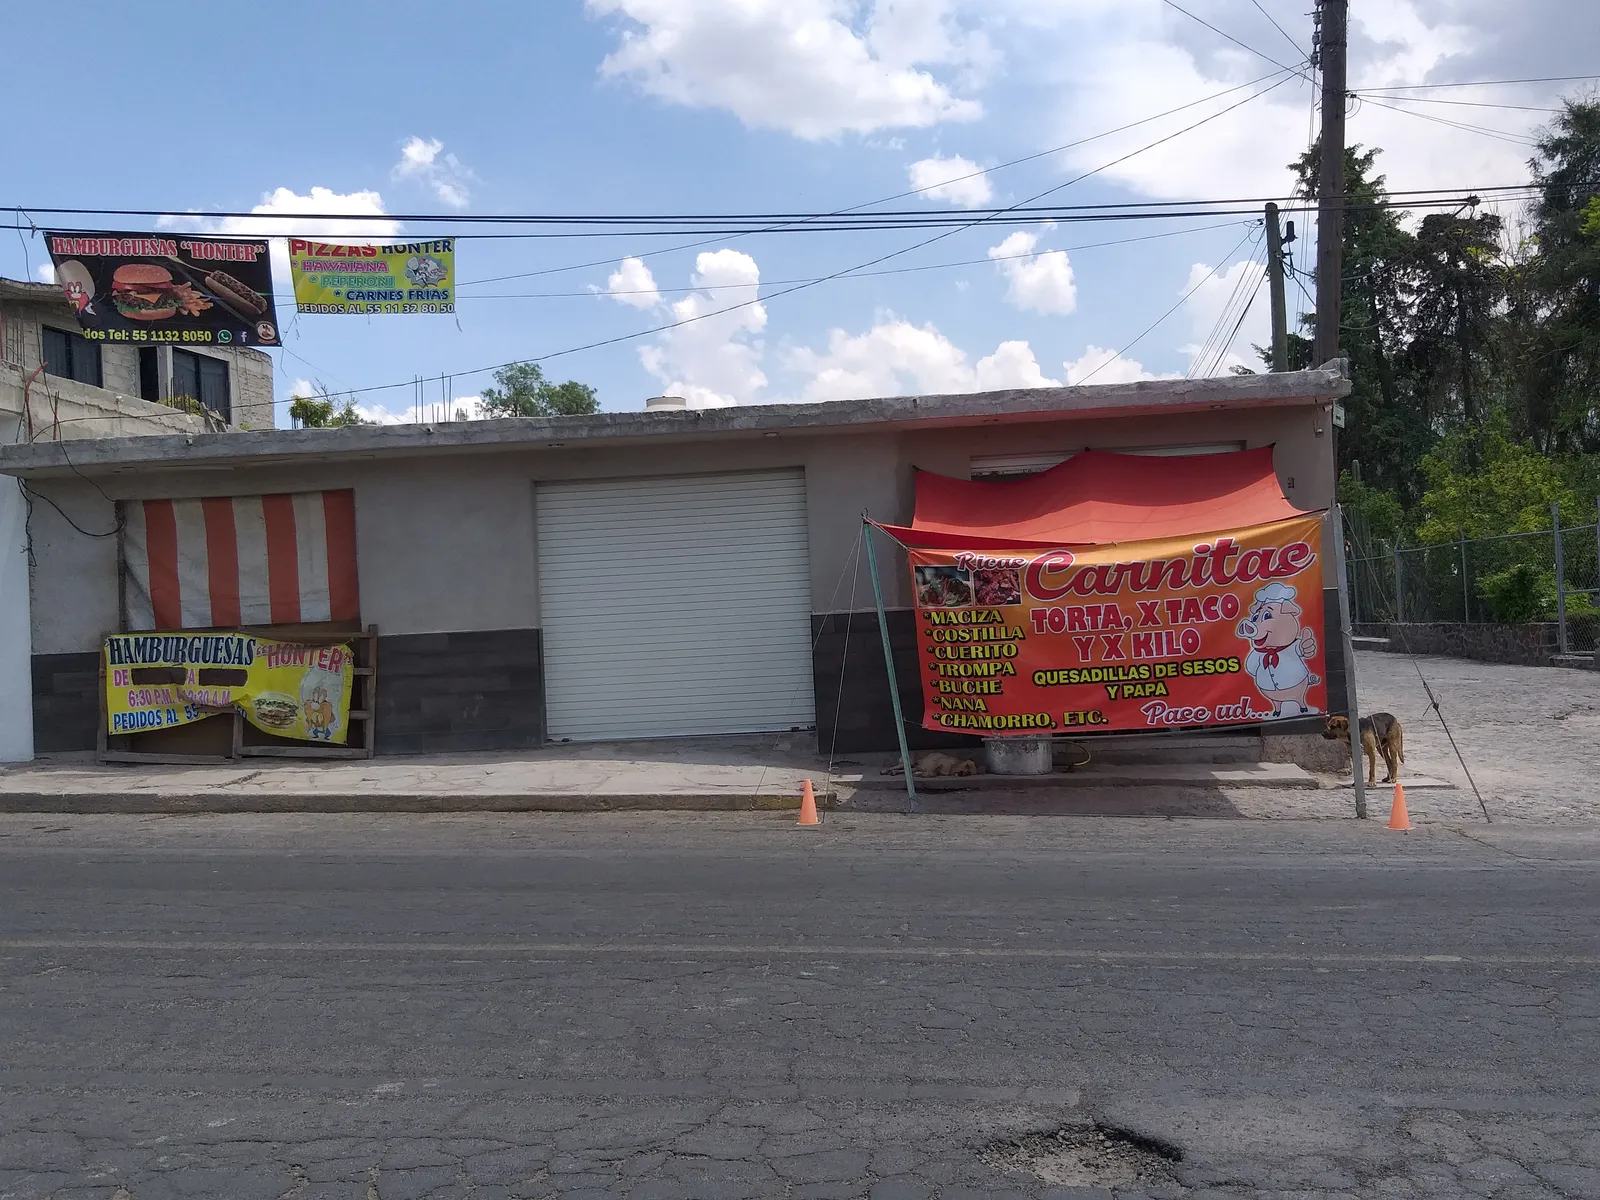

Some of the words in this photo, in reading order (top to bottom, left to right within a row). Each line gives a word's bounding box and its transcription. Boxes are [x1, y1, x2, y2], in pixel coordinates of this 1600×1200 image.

[52, 237, 177, 257] HAMBURGUESAS
[291, 239, 377, 257] PIZZAS
[381, 240, 453, 254] HONTER
[301, 260, 389, 273] HAWAIANA
[320, 275, 395, 288] PEPERONI
[345, 290, 404, 301] CARNES
[408, 290, 449, 301] FRIAS
[297, 303, 345, 314] PEDIDOS
[348, 303, 363, 314] AL
[366, 303, 381, 314] 55
[385, 303, 399, 314] 11
[402, 303, 418, 314] 32
[421, 303, 437, 314] 80
[440, 303, 454, 314] 50
[108, 329, 129, 340] Tel:
[132, 330, 147, 341] 55
[150, 330, 180, 342] 1132
[182, 331, 212, 342] 8050
[953, 551, 1028, 572] Ricas
[1024, 536, 1316, 601] Carnitas
[930, 610, 1003, 625] MACIZA
[1030, 602, 1133, 634] TORTA,
[1137, 600, 1162, 628] X
[1165, 593, 1241, 625] TACO
[932, 626, 1026, 642] COSTILLA
[107, 636, 257, 666] HAMBURGUESAS
[934, 643, 1019, 660] CUERITO
[1072, 635, 1096, 662] Y
[1102, 633, 1126, 661] X
[1131, 627, 1201, 659] KILO
[937, 661, 1017, 677] TROMPA
[1032, 664, 1151, 686] QUESADILLAS
[1154, 663, 1179, 679] DE
[1182, 658, 1241, 675] SESOS
[113, 669, 129, 687] DE
[188, 669, 195, 685] A
[939, 680, 1003, 694] BUCHE
[1106, 685, 1119, 700] Y
[1123, 682, 1169, 699] PAPA
[128, 689, 152, 708] 6:30
[154, 688, 175, 706] P.M.
[940, 696, 988, 712] NANA
[113, 708, 162, 731] PEDIDOS
[166, 708, 179, 724] AL
[1063, 710, 1109, 727] ETC.
